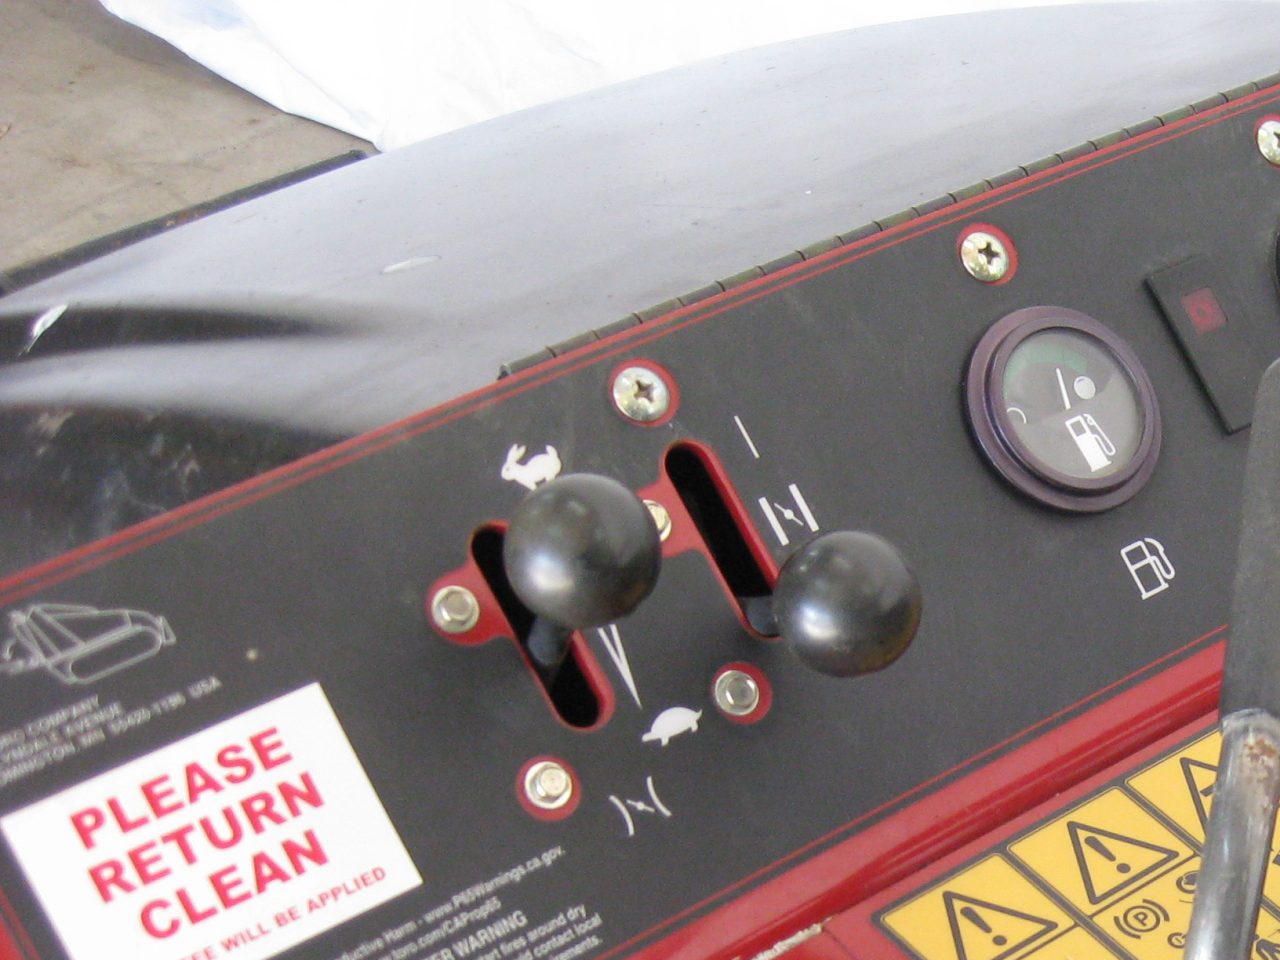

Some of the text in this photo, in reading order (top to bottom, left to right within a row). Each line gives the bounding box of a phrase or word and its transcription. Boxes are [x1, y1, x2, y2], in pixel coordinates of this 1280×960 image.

[189, 675, 221, 697] USA
[26, 695, 100, 735] COMPANY
[64, 702, 122, 735] AVENUE
[69, 726, 293, 851] PLEASE
[87, 771, 325, 904] RETURN
[140, 829, 329, 940] CLEAN
[220, 922, 270, 952] WILL
[274, 906, 302, 928] BE
[307, 866, 387, 914] APPLIED
[384, 920, 416, 943] Harm
[453, 909, 528, 957] WARNING
[499, 934, 526, 954] fires
[526, 914, 566, 940] around
[565, 903, 587, 922] dry
[532, 928, 575, 957] contact
[573, 913, 601, 935] local
